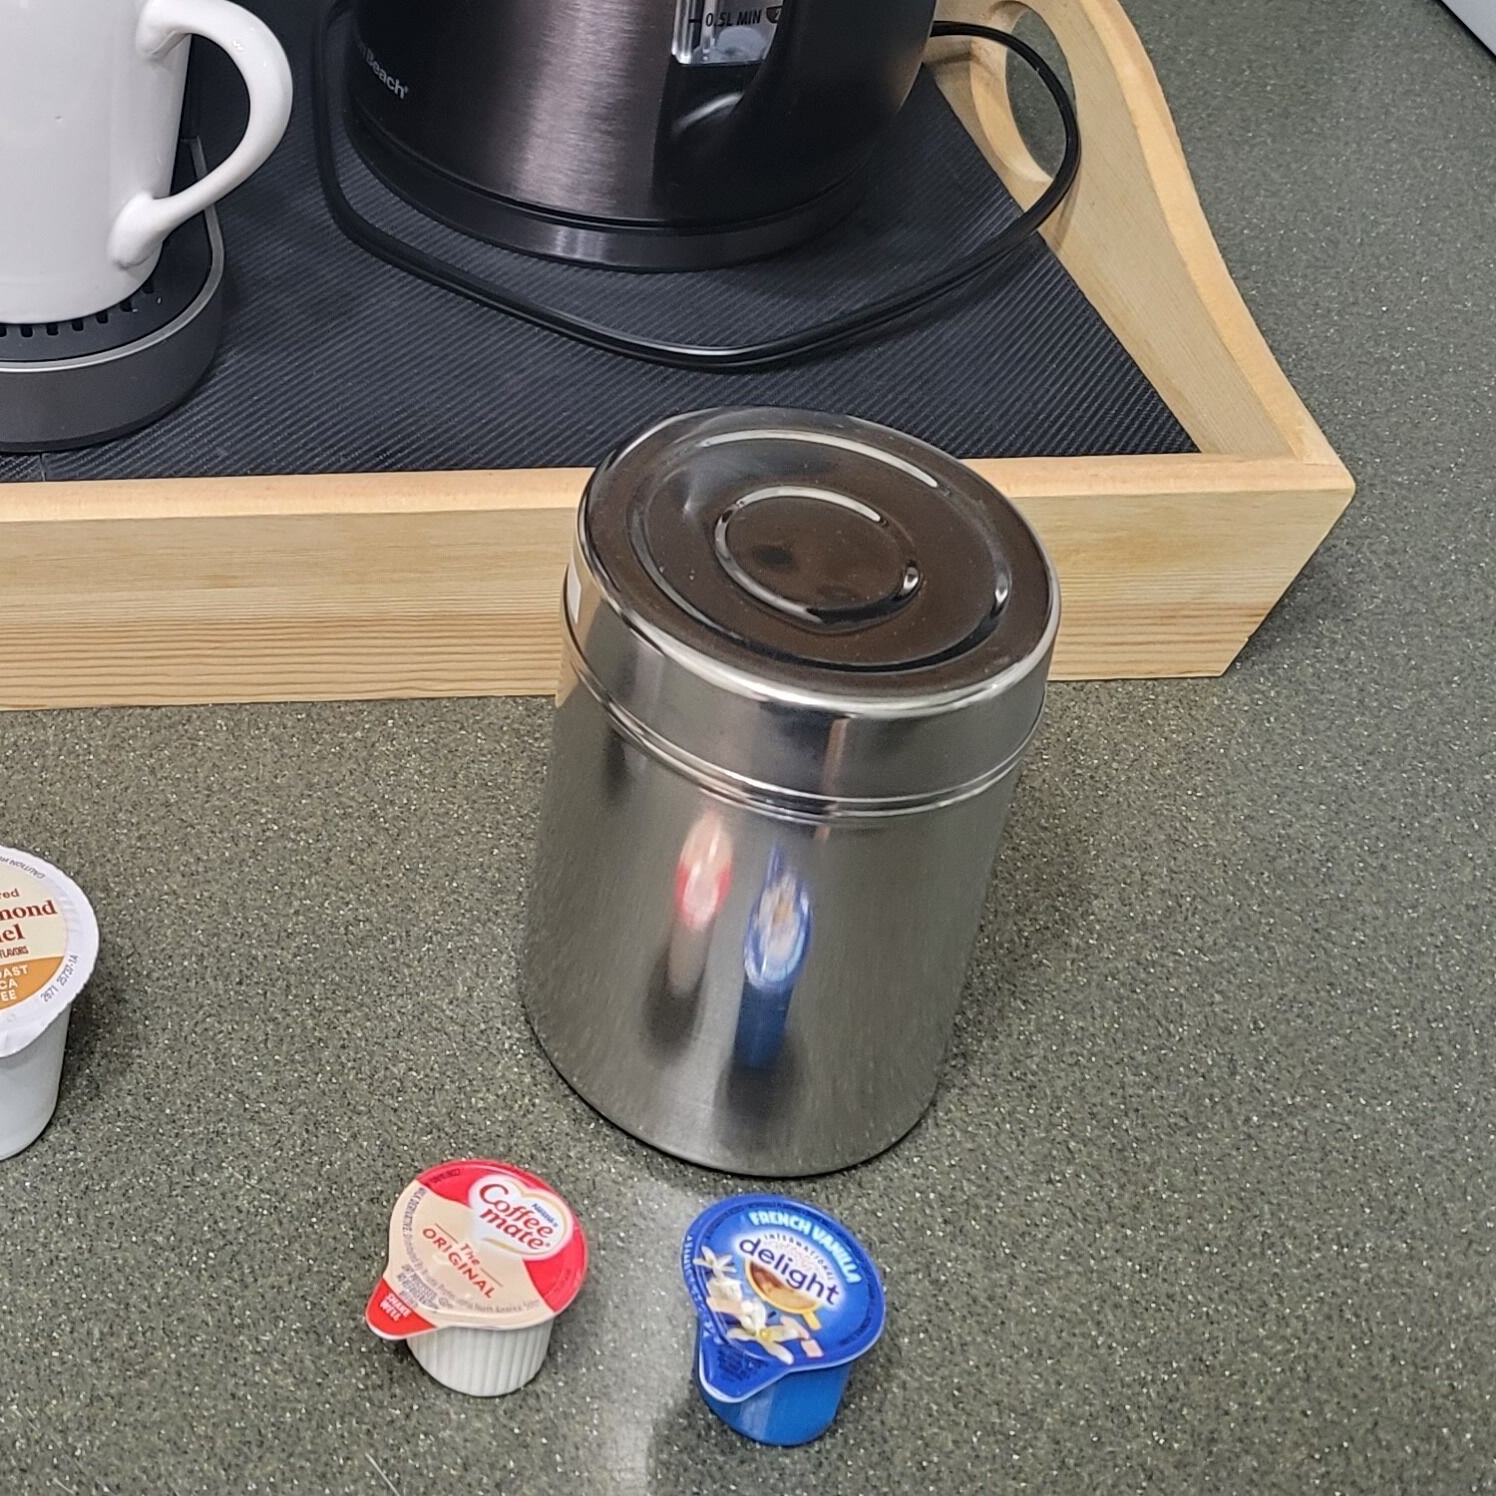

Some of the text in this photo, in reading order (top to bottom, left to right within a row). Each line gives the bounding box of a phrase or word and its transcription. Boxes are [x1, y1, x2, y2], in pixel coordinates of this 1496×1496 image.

[705, 9, 762, 27] 0.5L MIN
[7, 858, 46, 880] CAUTION
[0, 945, 30, 960] FLAVORS
[479, 1184, 554, 1238] Coffee
[480, 1209, 545, 1250] mate
[422, 1228, 496, 1299] ORIGINAL
[460, 1243, 481, 1266] The
[749, 1211, 811, 1236] FRENCH
[810, 1225, 862, 1284] VANILLA
[739, 1237, 840, 1305] delight
